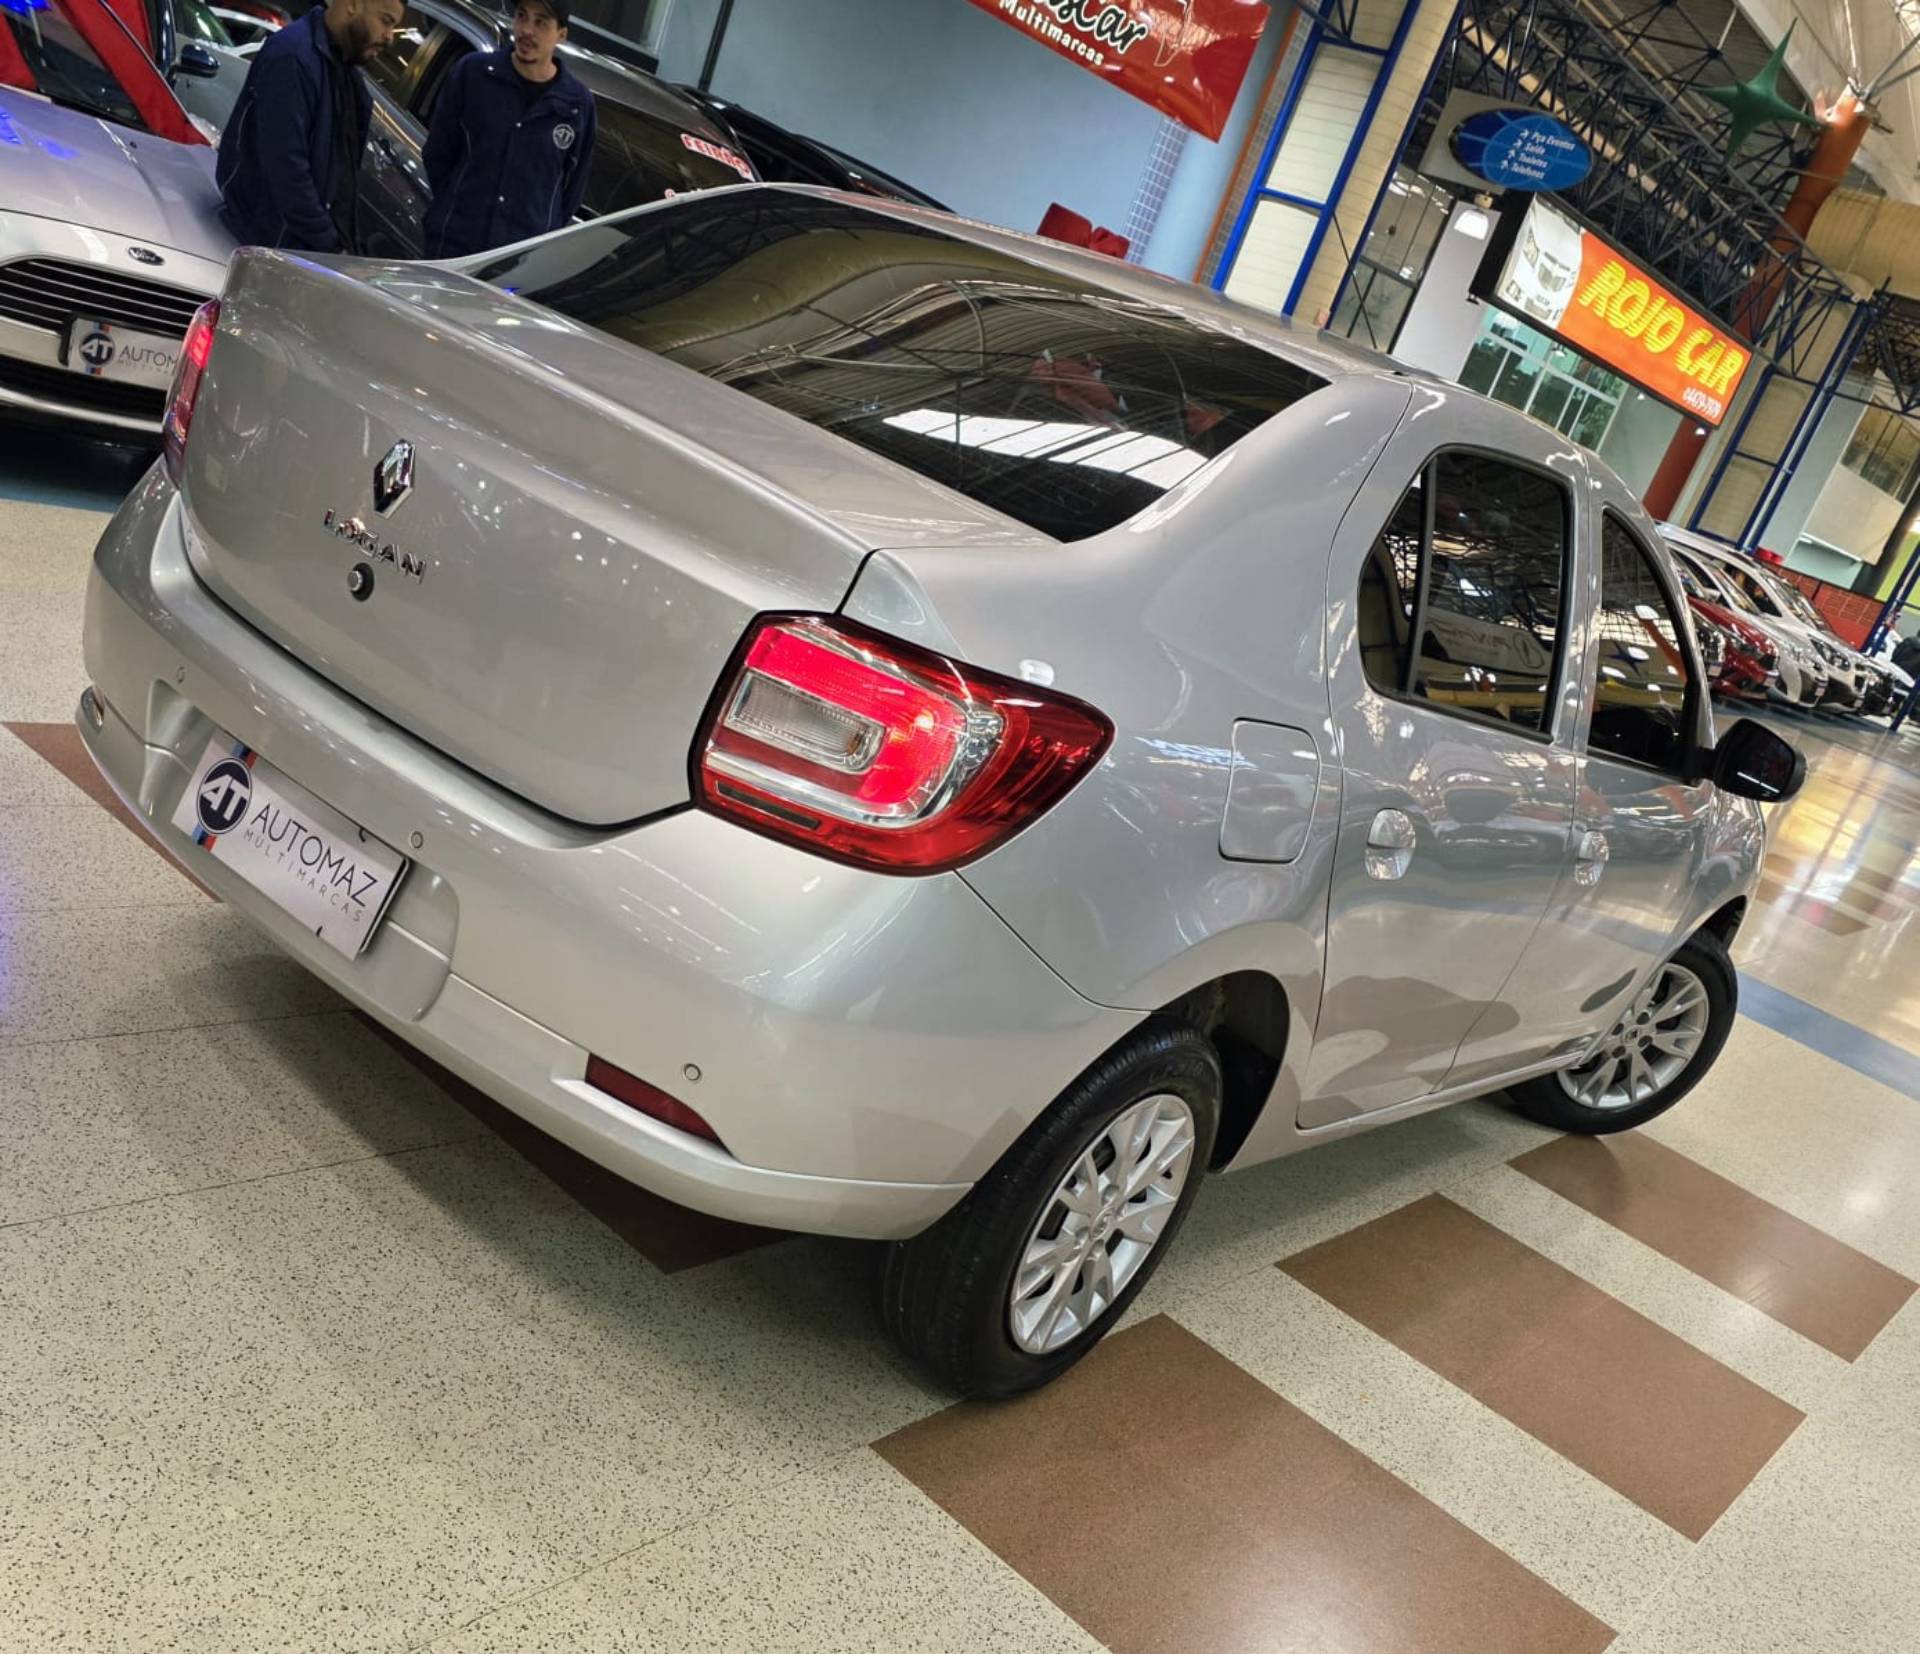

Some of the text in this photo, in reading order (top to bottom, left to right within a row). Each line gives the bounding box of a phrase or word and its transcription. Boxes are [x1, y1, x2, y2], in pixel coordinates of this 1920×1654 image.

[999, 0, 1105, 66] Multimarcas
[118, 345, 179, 368] AUTOM
[1577, 259, 1745, 396] ROJO CAR
[323, 508, 427, 585] LOGAN
[243, 829, 364, 923] MULTIMARCAS
[251, 803, 378, 908] AUTOMAZ
